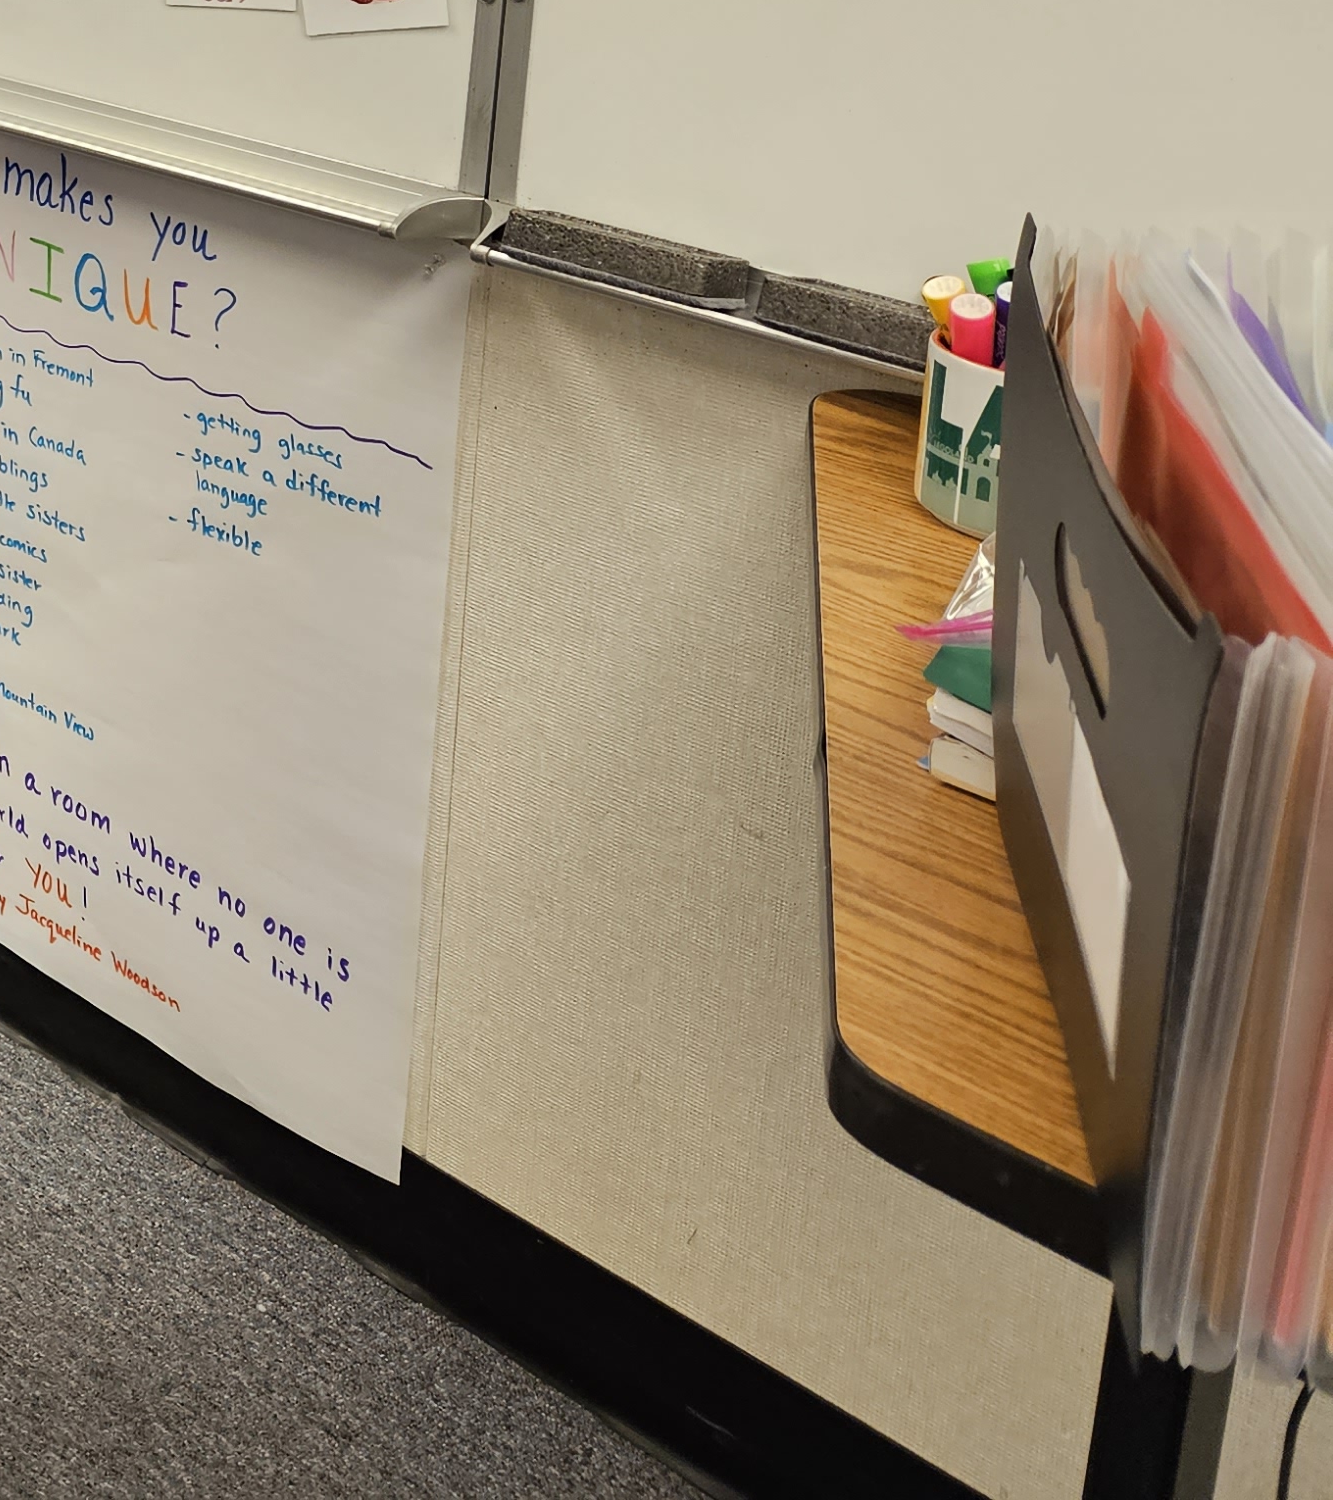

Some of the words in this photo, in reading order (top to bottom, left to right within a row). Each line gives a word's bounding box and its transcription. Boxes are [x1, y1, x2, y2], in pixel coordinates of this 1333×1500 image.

[3, 152, 114, 227] makes
[150, 211, 217, 261] you
[9, 347, 26, 366] in
[33, 349, 93, 388] Fremont
[10, 374, 32, 406] fu
[0, 422, 19, 445] in
[29, 426, 87, 466] Canada
[196, 411, 261, 454] getting
[278, 433, 343, 470] glasses
[191, 447, 249, 477] speak
[262, 470, 277, 488] a
[285, 468, 382, 518] different
[196, 470, 268, 518] language
[26, 503, 85, 542] sisters
[0, 534, 47, 563] comics
[63, 711, 94, 741] View
[24, 772, 41, 796] a
[50, 786, 111, 835] room
[129, 831, 201, 889] where
[218, 886, 246, 918] no
[263, 916, 307, 956] one
[327, 947, 350, 982] is
[42, 833, 100, 876] opens
[115, 861, 182, 916] itself
[195, 916, 220, 949] up
[233, 942, 250, 964] a
[272, 955, 333, 1012] little
[15, 893, 102, 962] Jacqueline
[110, 950, 181, 1013] Woodson
